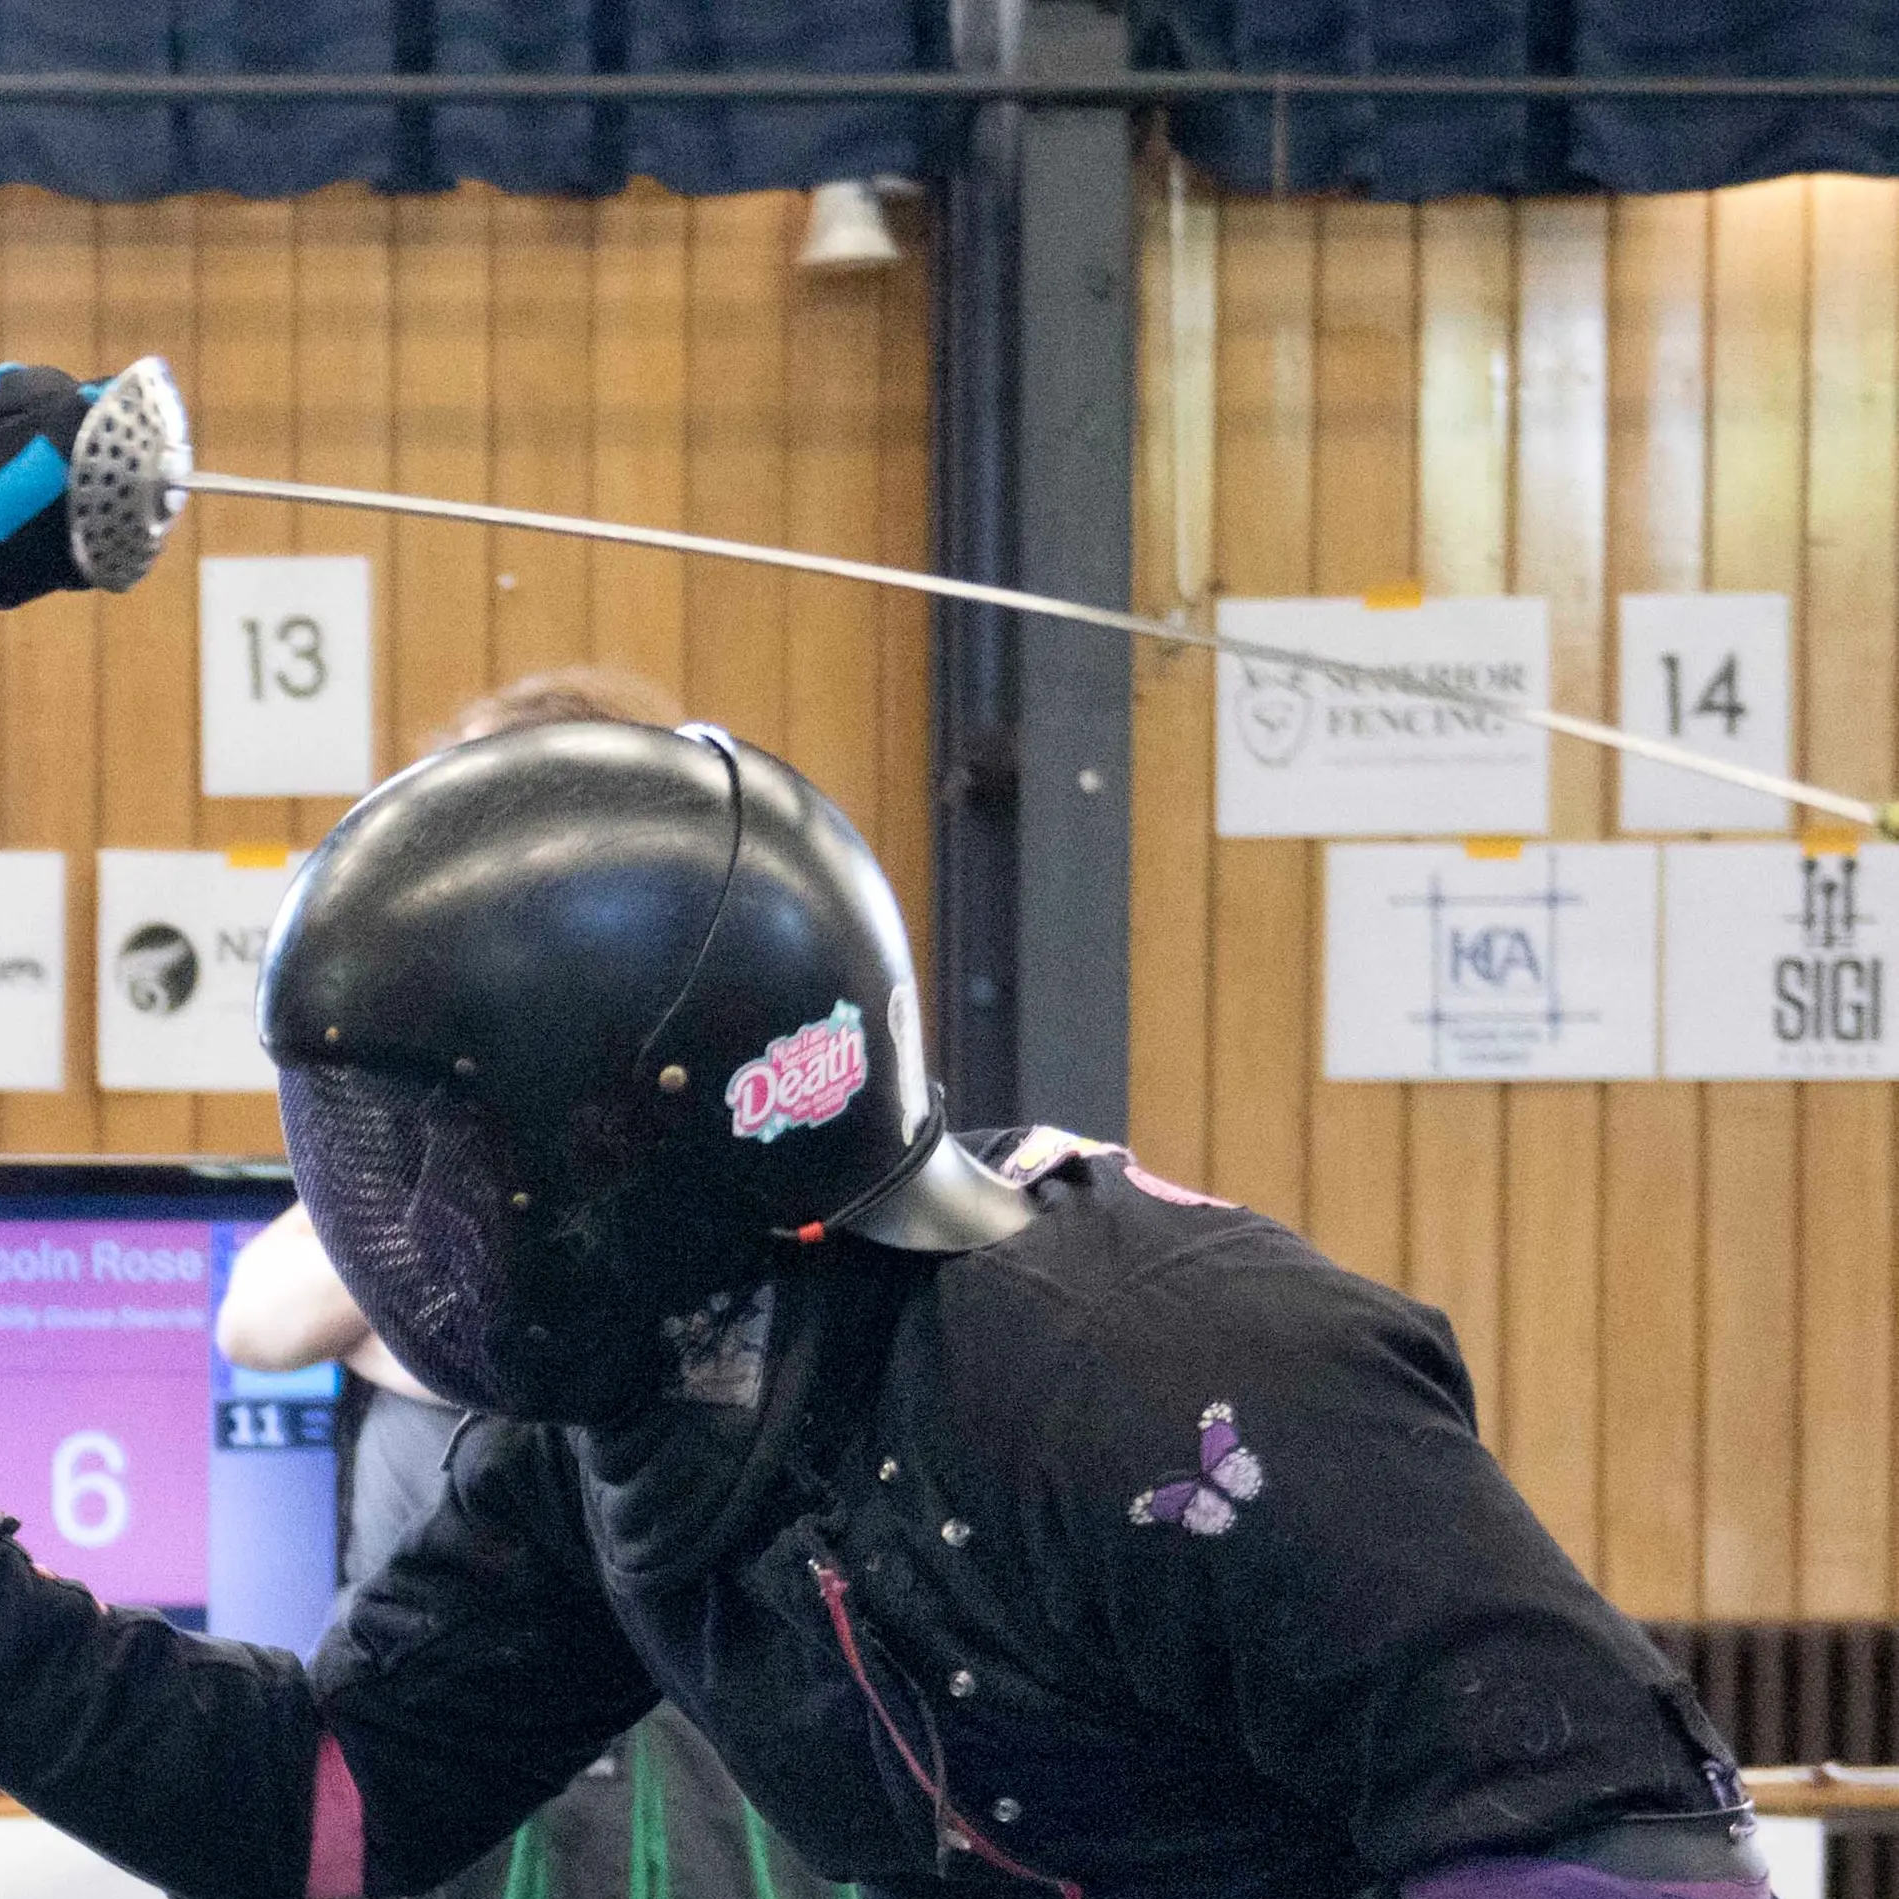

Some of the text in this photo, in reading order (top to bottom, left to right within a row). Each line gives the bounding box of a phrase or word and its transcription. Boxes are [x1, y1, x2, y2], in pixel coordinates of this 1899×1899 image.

[239, 614, 329, 702] 13
[1656, 648, 1748, 738] 14
[726, 1024, 863, 1126] Death
[93, 1239, 205, 1284] Rose
[229, 1405, 285, 1446] 11
[51, 1430, 131, 1549] 6
